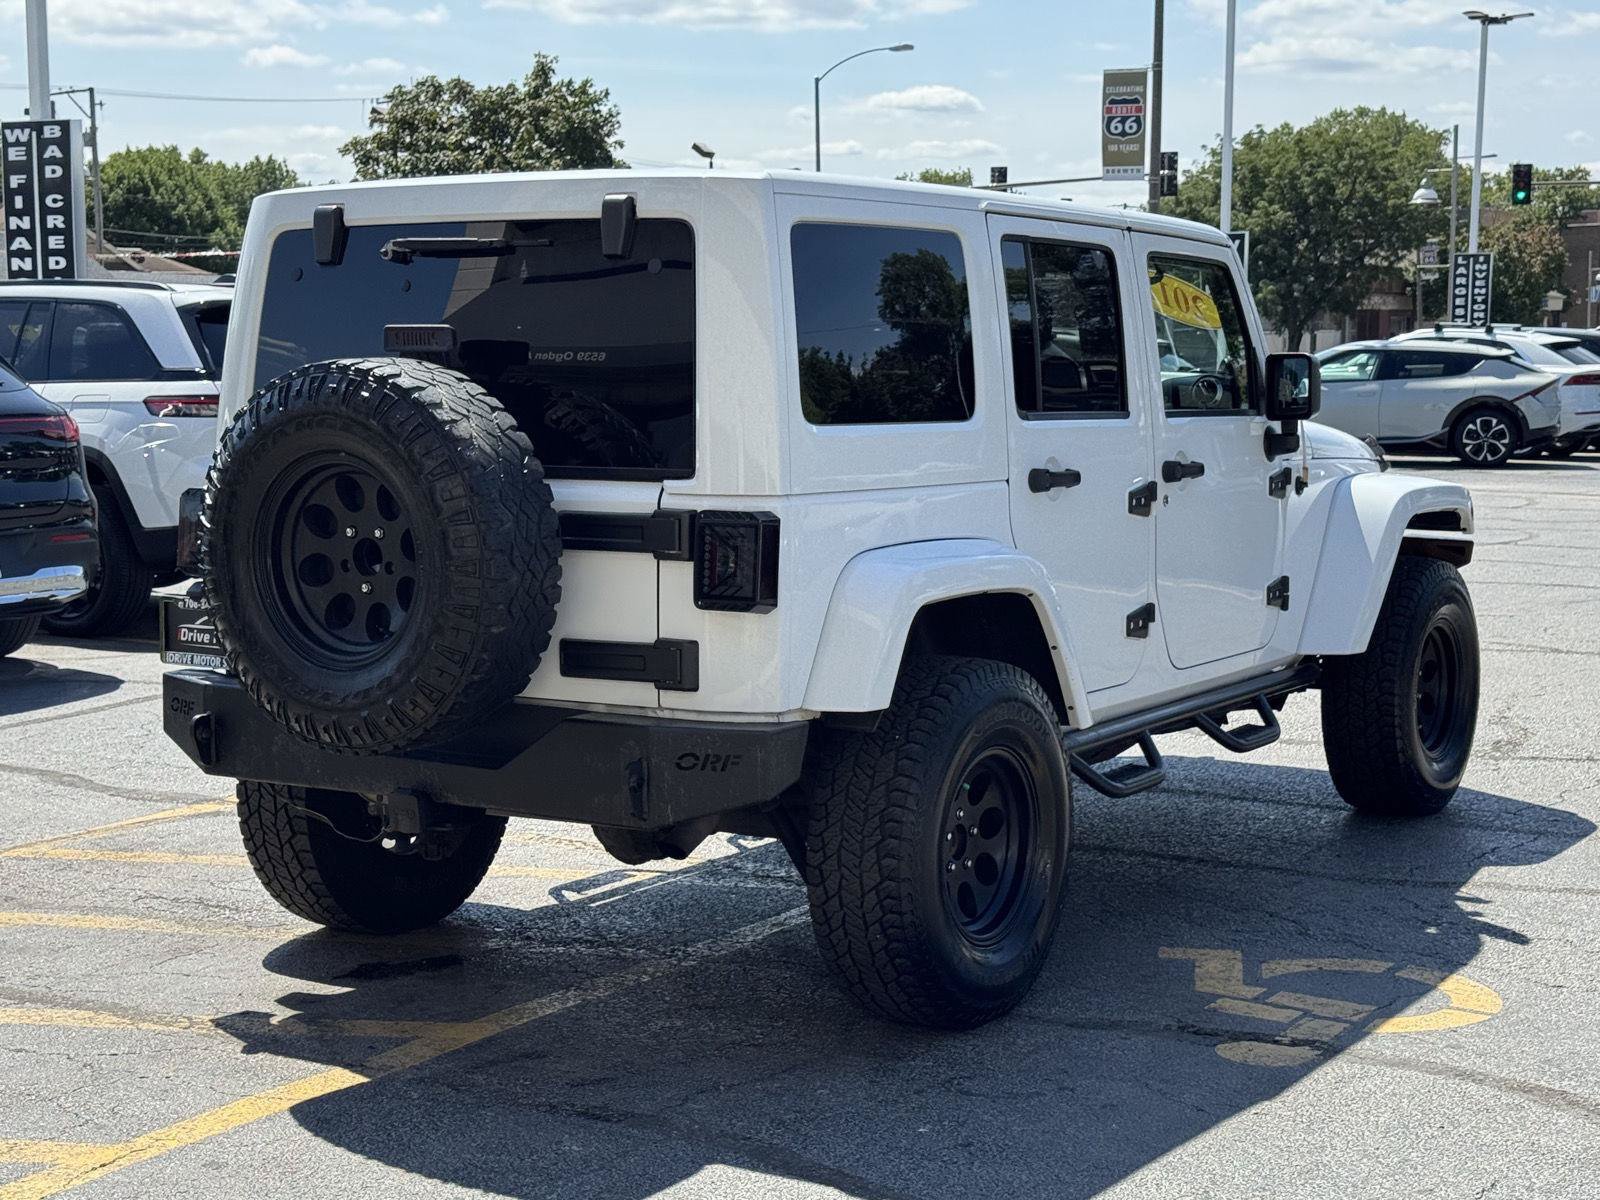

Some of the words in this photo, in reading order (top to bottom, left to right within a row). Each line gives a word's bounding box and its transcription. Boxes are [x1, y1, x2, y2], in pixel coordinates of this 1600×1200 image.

[1110, 117, 1138, 134] 66
[1112, 106, 1136, 114] ROUTE
[4, 128, 31, 161] WE
[42, 125, 64, 179] BAD
[9, 174, 33, 279] FINAN
[45, 194, 67, 279] CRED
[1473, 256, 1488, 326] INVENTORY
[170, 697, 194, 715] ORF
[675, 752, 742, 772] ORF
